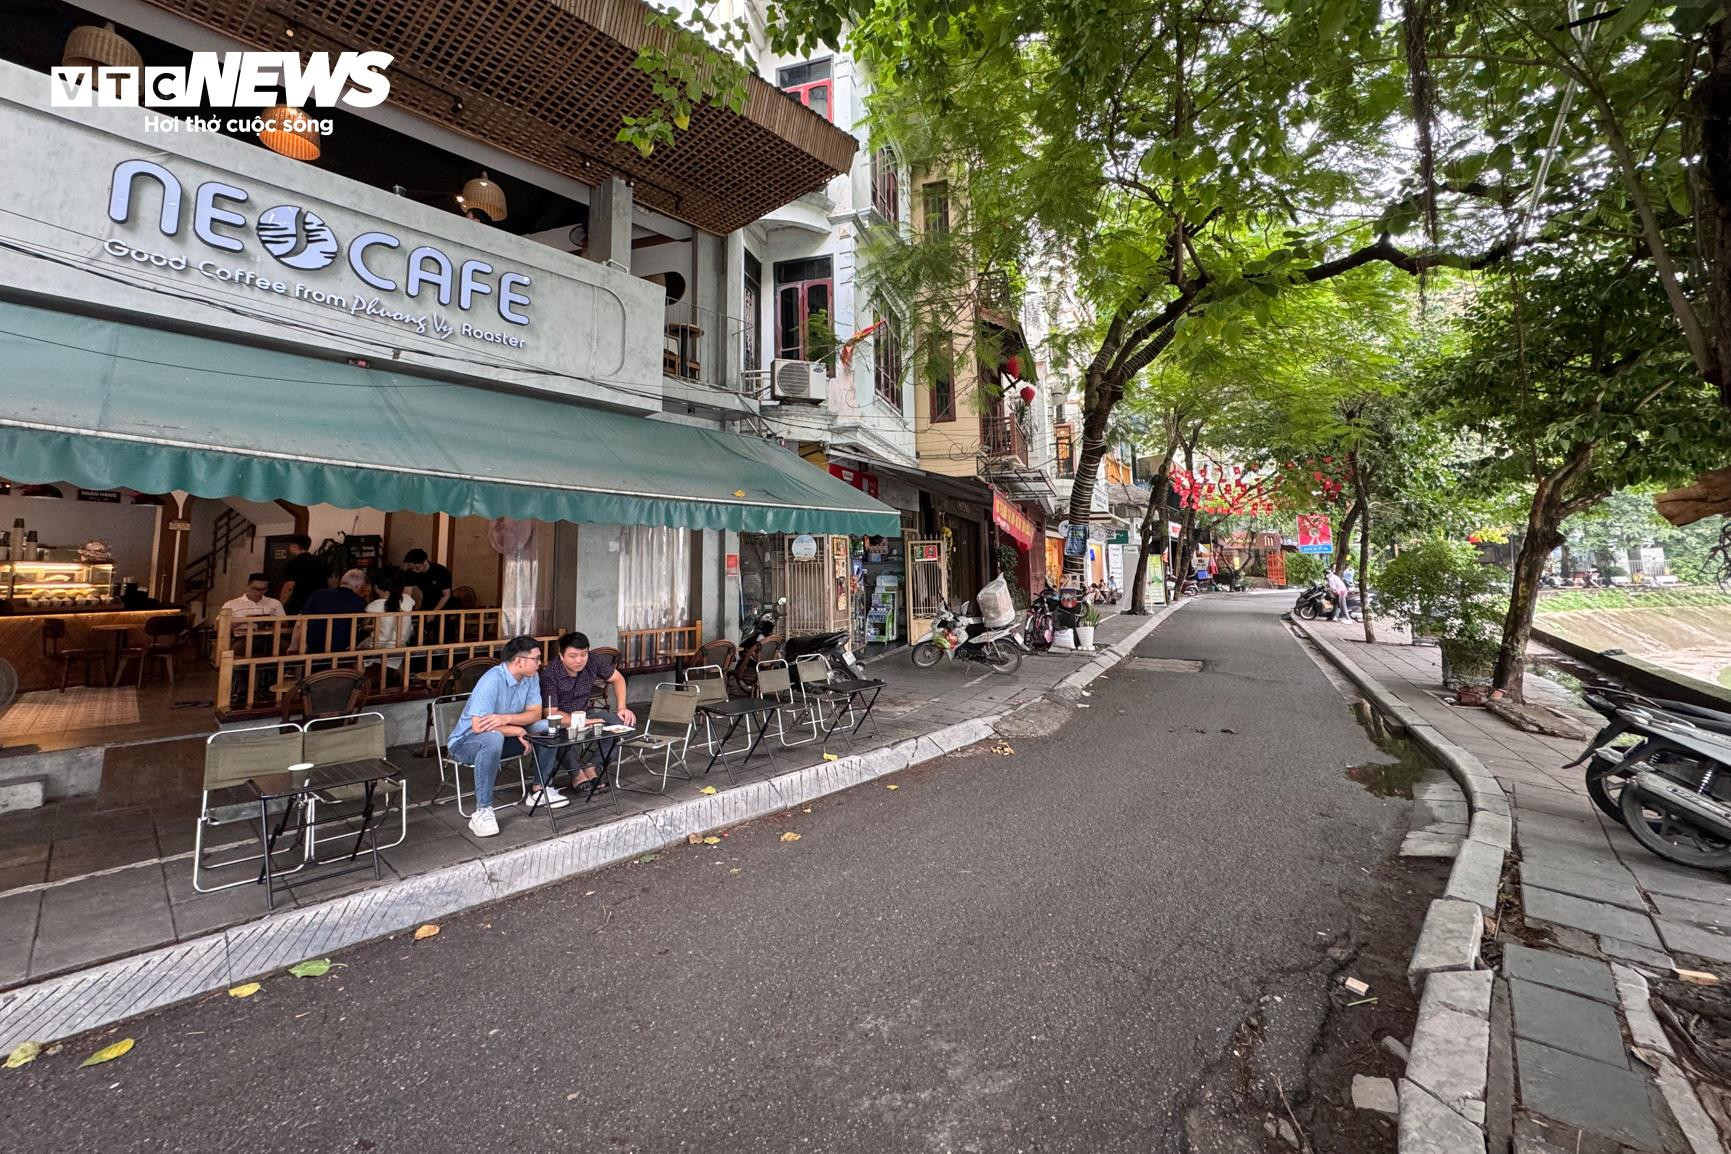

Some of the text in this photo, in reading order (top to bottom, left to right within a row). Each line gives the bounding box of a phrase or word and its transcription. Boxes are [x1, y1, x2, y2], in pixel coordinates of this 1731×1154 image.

[103, 238, 188, 273] Good
[199, 260, 288, 294] Coffee
[294, 283, 347, 308] from
[432, 312, 455, 340] Vy
[460, 322, 526, 349] Roaster
